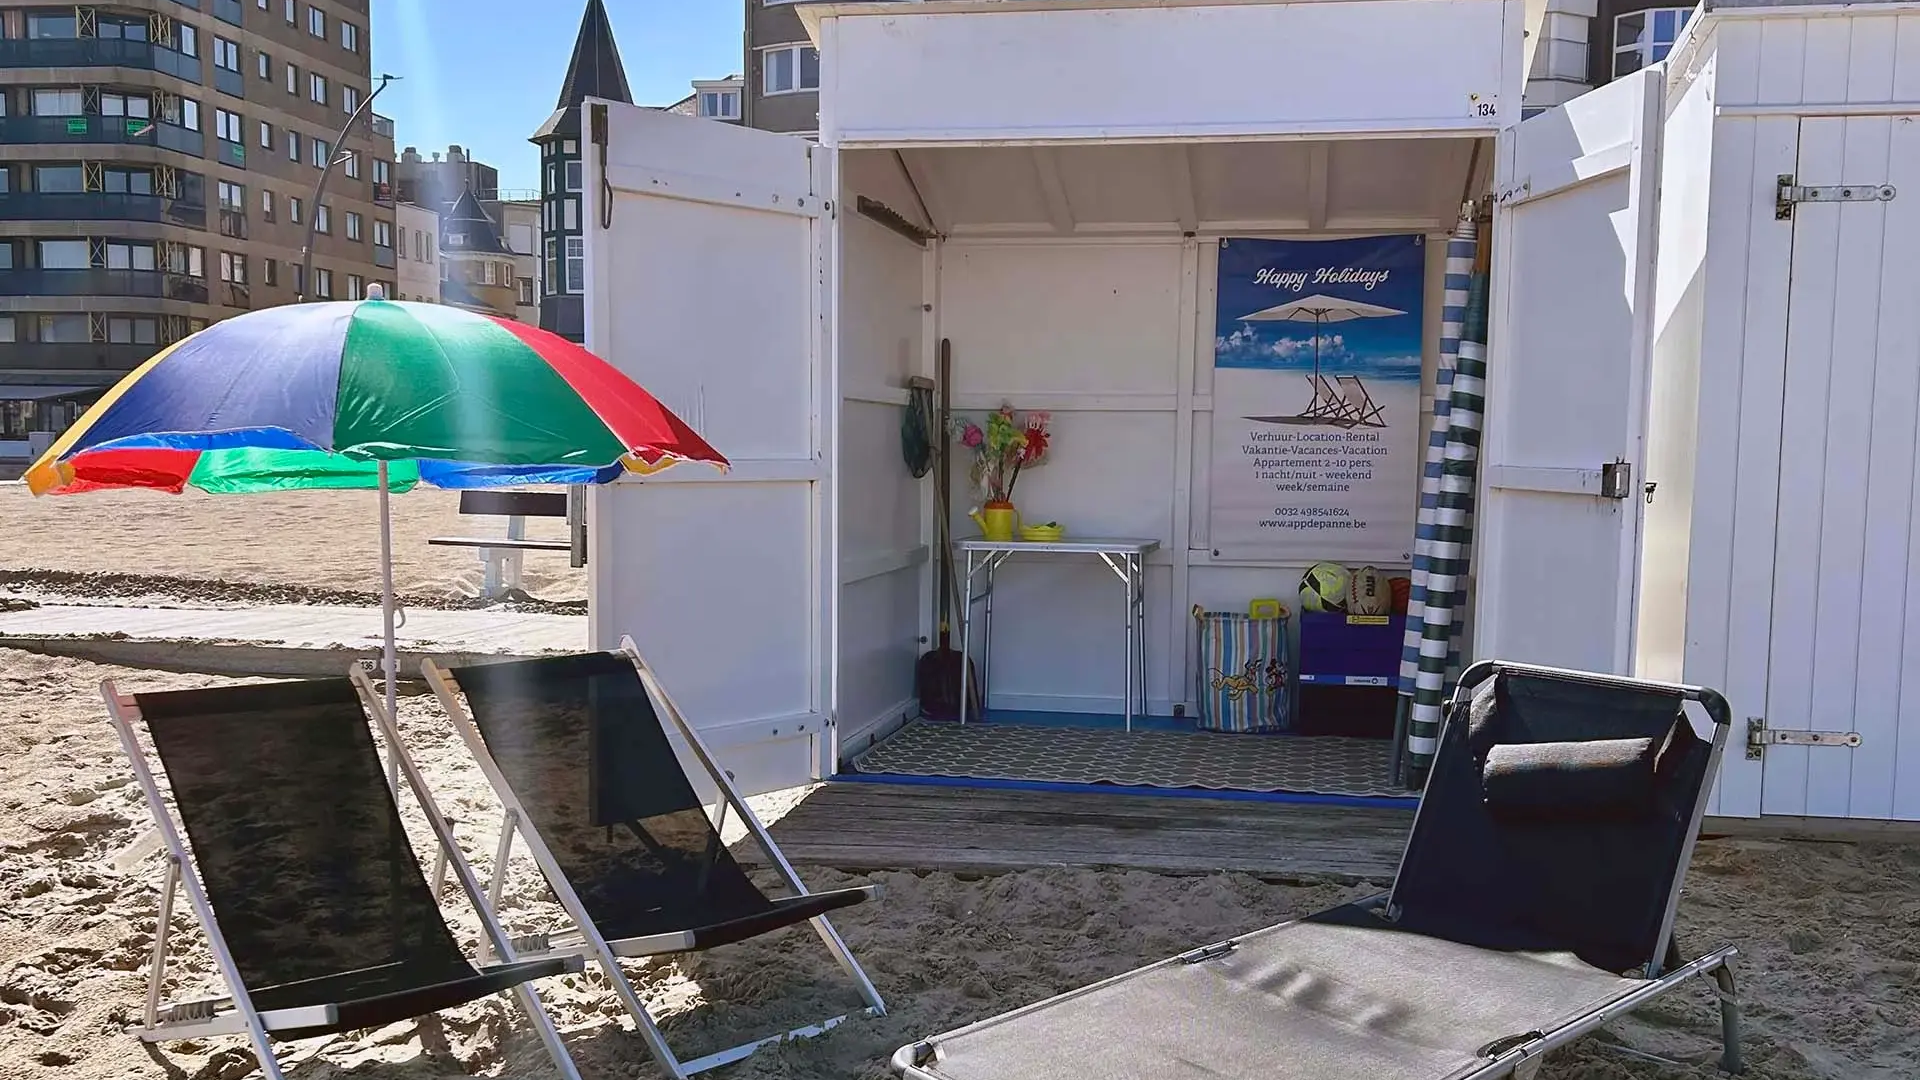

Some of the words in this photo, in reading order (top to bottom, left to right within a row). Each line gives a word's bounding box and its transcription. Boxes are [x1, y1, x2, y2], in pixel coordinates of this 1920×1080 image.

[1477, 103, 1496, 117] 134
[1253, 267, 1308, 292] Happy
[1312, 265, 1390, 291] Holidays
[1250, 431, 1380, 442] Verhuur-Location-Rental
[1242, 445, 1388, 455] Vakantie-Vacances-Vacation
[1253, 458, 1322, 469] Appartement
[1349, 459, 1374, 470] pers.
[1261, 470, 1317, 480] nacht/nuit
[1325, 470, 1372, 480] weekend
[1275, 482, 1350, 492] week/semaine
[1274, 507, 1299, 516] 0032
[1300, 507, 1350, 517] 498541624
[1259, 519, 1367, 530] www.appdepanne.be
